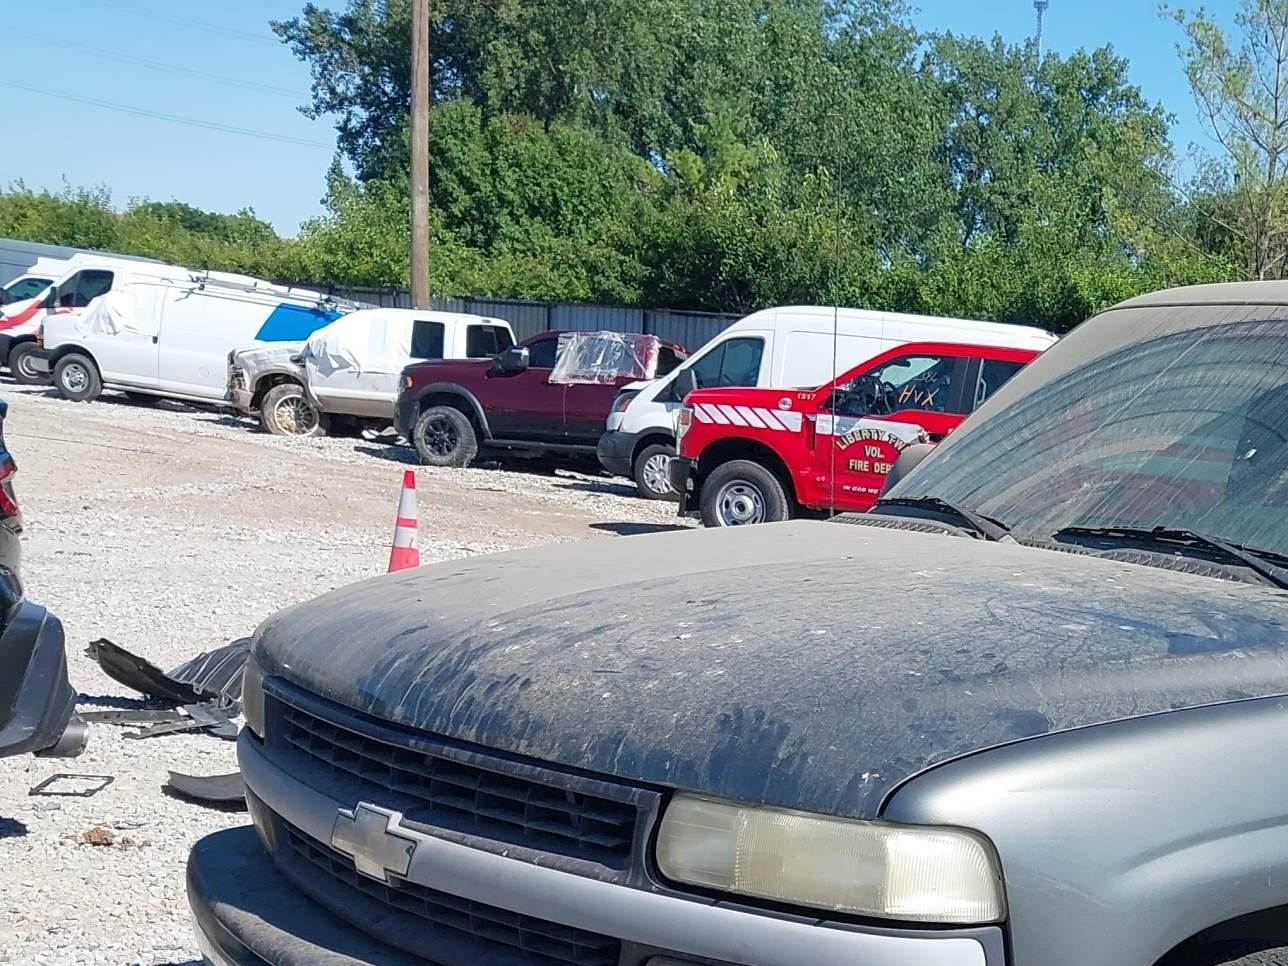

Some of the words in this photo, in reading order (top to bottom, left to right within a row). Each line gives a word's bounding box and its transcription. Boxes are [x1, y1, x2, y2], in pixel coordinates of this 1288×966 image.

[834, 428, 886, 450] LIBERTY
[887, 432, 907, 453] TW
[848, 458, 870, 472] FIRE
[851, 485, 867, 493] GOD
[867, 487, 879, 495] WE
